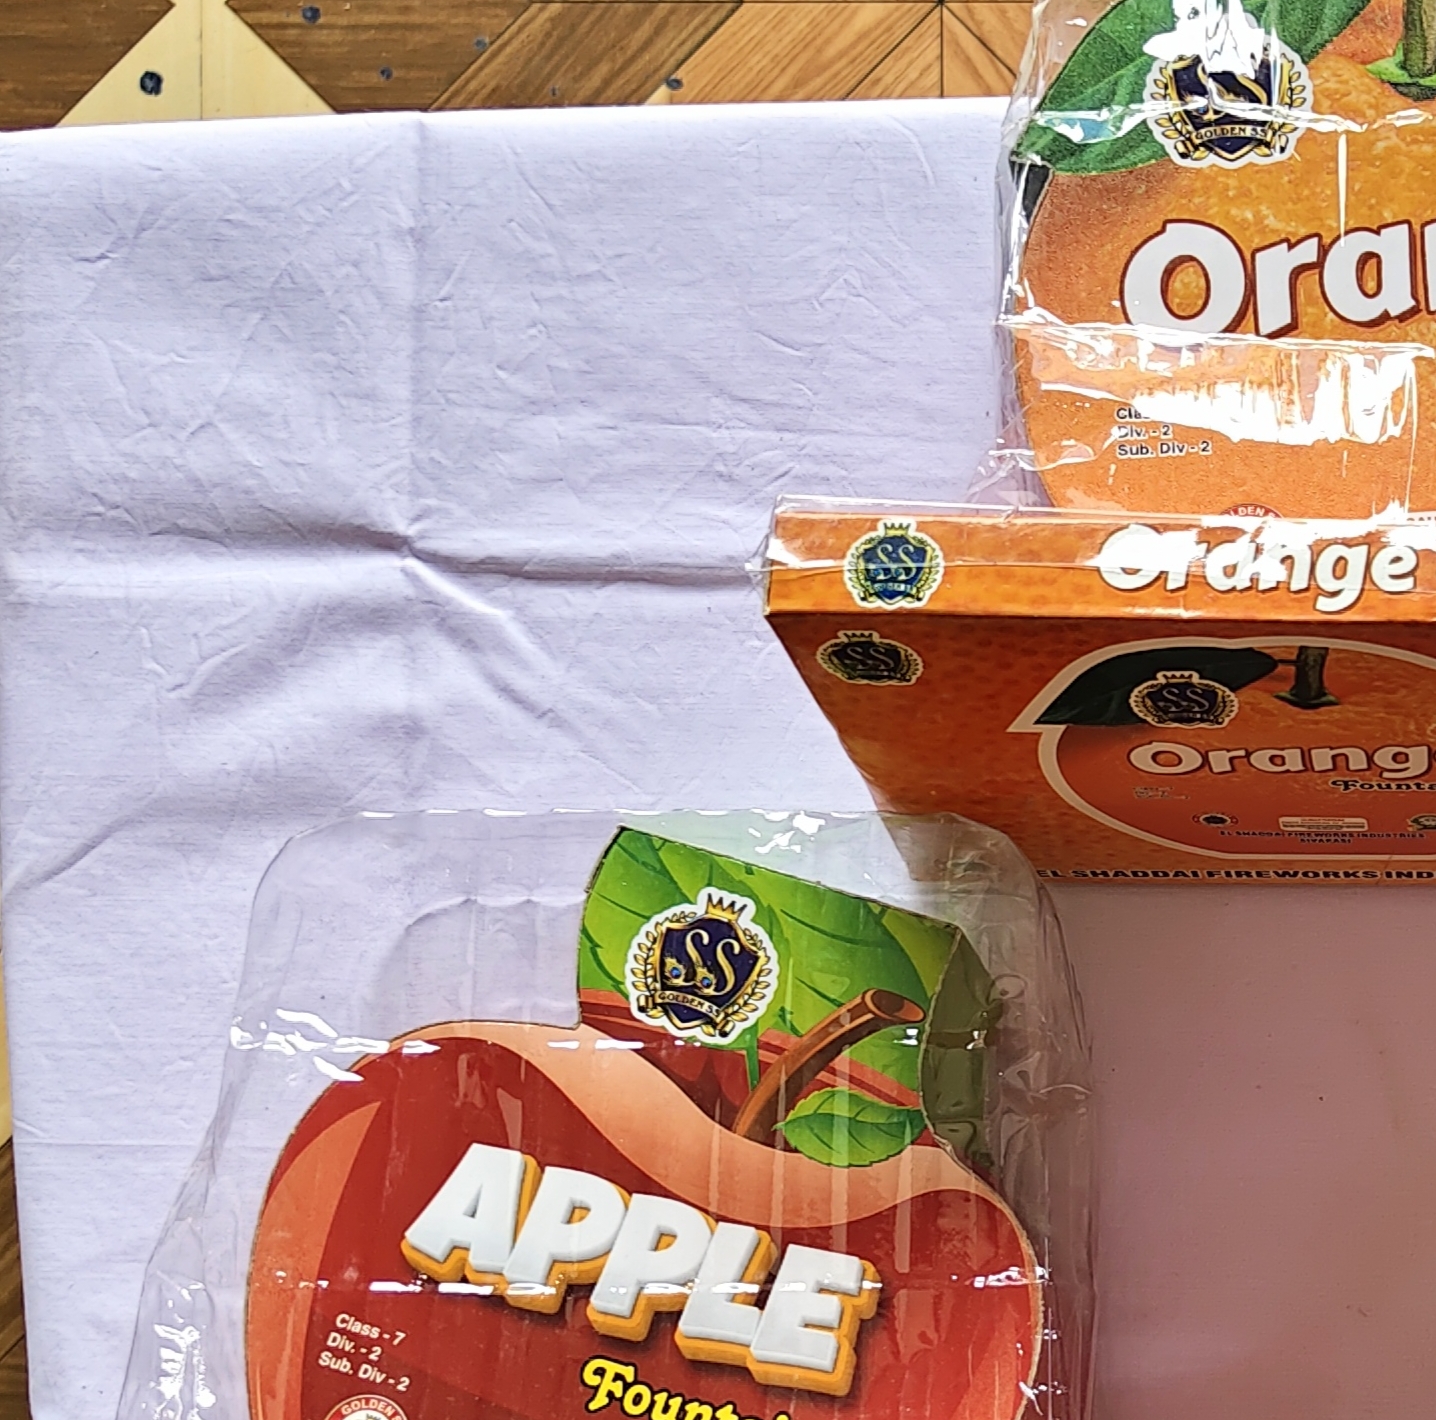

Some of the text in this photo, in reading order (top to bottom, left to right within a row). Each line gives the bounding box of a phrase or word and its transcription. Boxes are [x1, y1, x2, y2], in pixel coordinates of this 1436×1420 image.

[1118, 444, 1154, 456] Sub.
[1160, 443, 1185, 454] Div
[1036, 870, 1058, 878] EL
[1073, 870, 1200, 878] SHADDAI
[1205, 870, 1379, 879] FIREWORKS
[400, 1142, 882, 1396] APPLE
[335, 1313, 380, 1339] Class
[327, 1332, 355, 1353] Div.
[318, 1351, 353, 1375] Sub.
[358, 1364, 386, 1383] Div
[341, 1398, 396, 1417] GOLDEN
